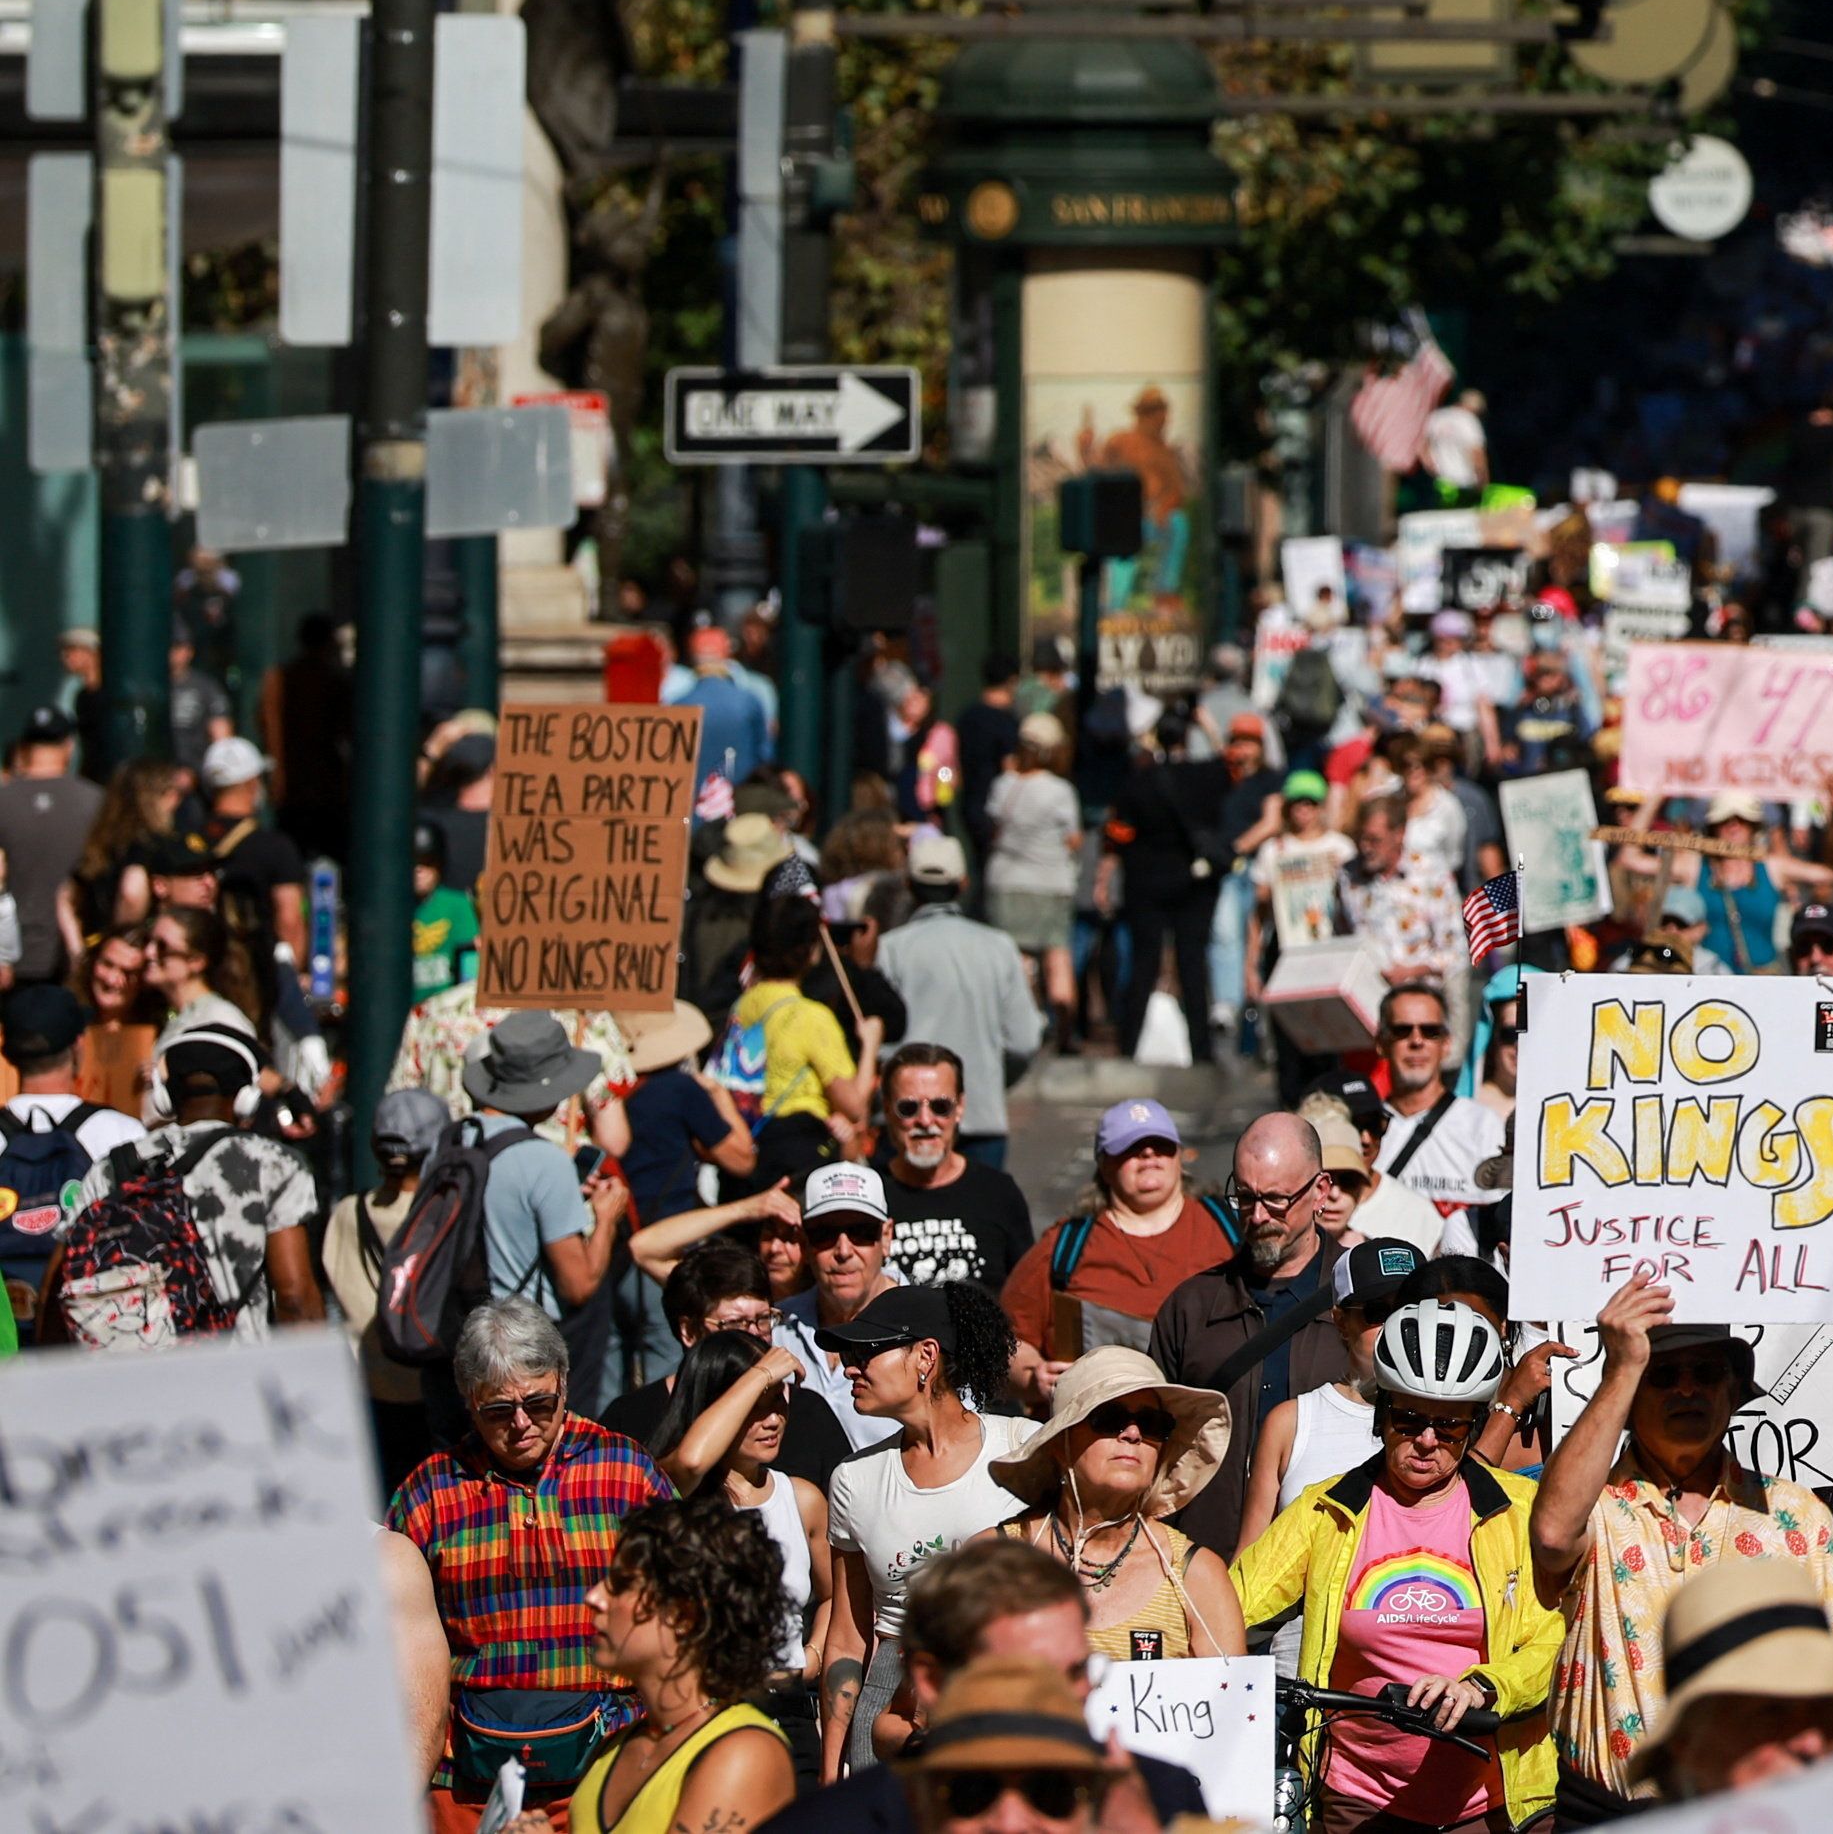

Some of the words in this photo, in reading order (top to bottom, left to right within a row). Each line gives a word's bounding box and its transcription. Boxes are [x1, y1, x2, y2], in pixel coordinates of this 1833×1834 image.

[504, 713, 560, 757] THE
[569, 712, 699, 763] BOSTON
[502, 772, 563, 816] TEA
[582, 773, 684, 814] PARTY
[497, 818, 575, 865] WAS
[603, 818, 663, 865] THE
[492, 870, 669, 925] ORIGINAL
[483, 936, 528, 994] NO
[537, 933, 613, 993] KINGS
[613, 940, 673, 995] RALLY
[1586, 998, 1761, 1091] NO
[895, 1219, 967, 1239] REBEL
[1544, 1200, 1726, 1248] JUSTICE
[1601, 1252, 1694, 1285] FOR
[1735, 1239, 1830, 1294] ALL
[1128, 1671, 1214, 1740] King
